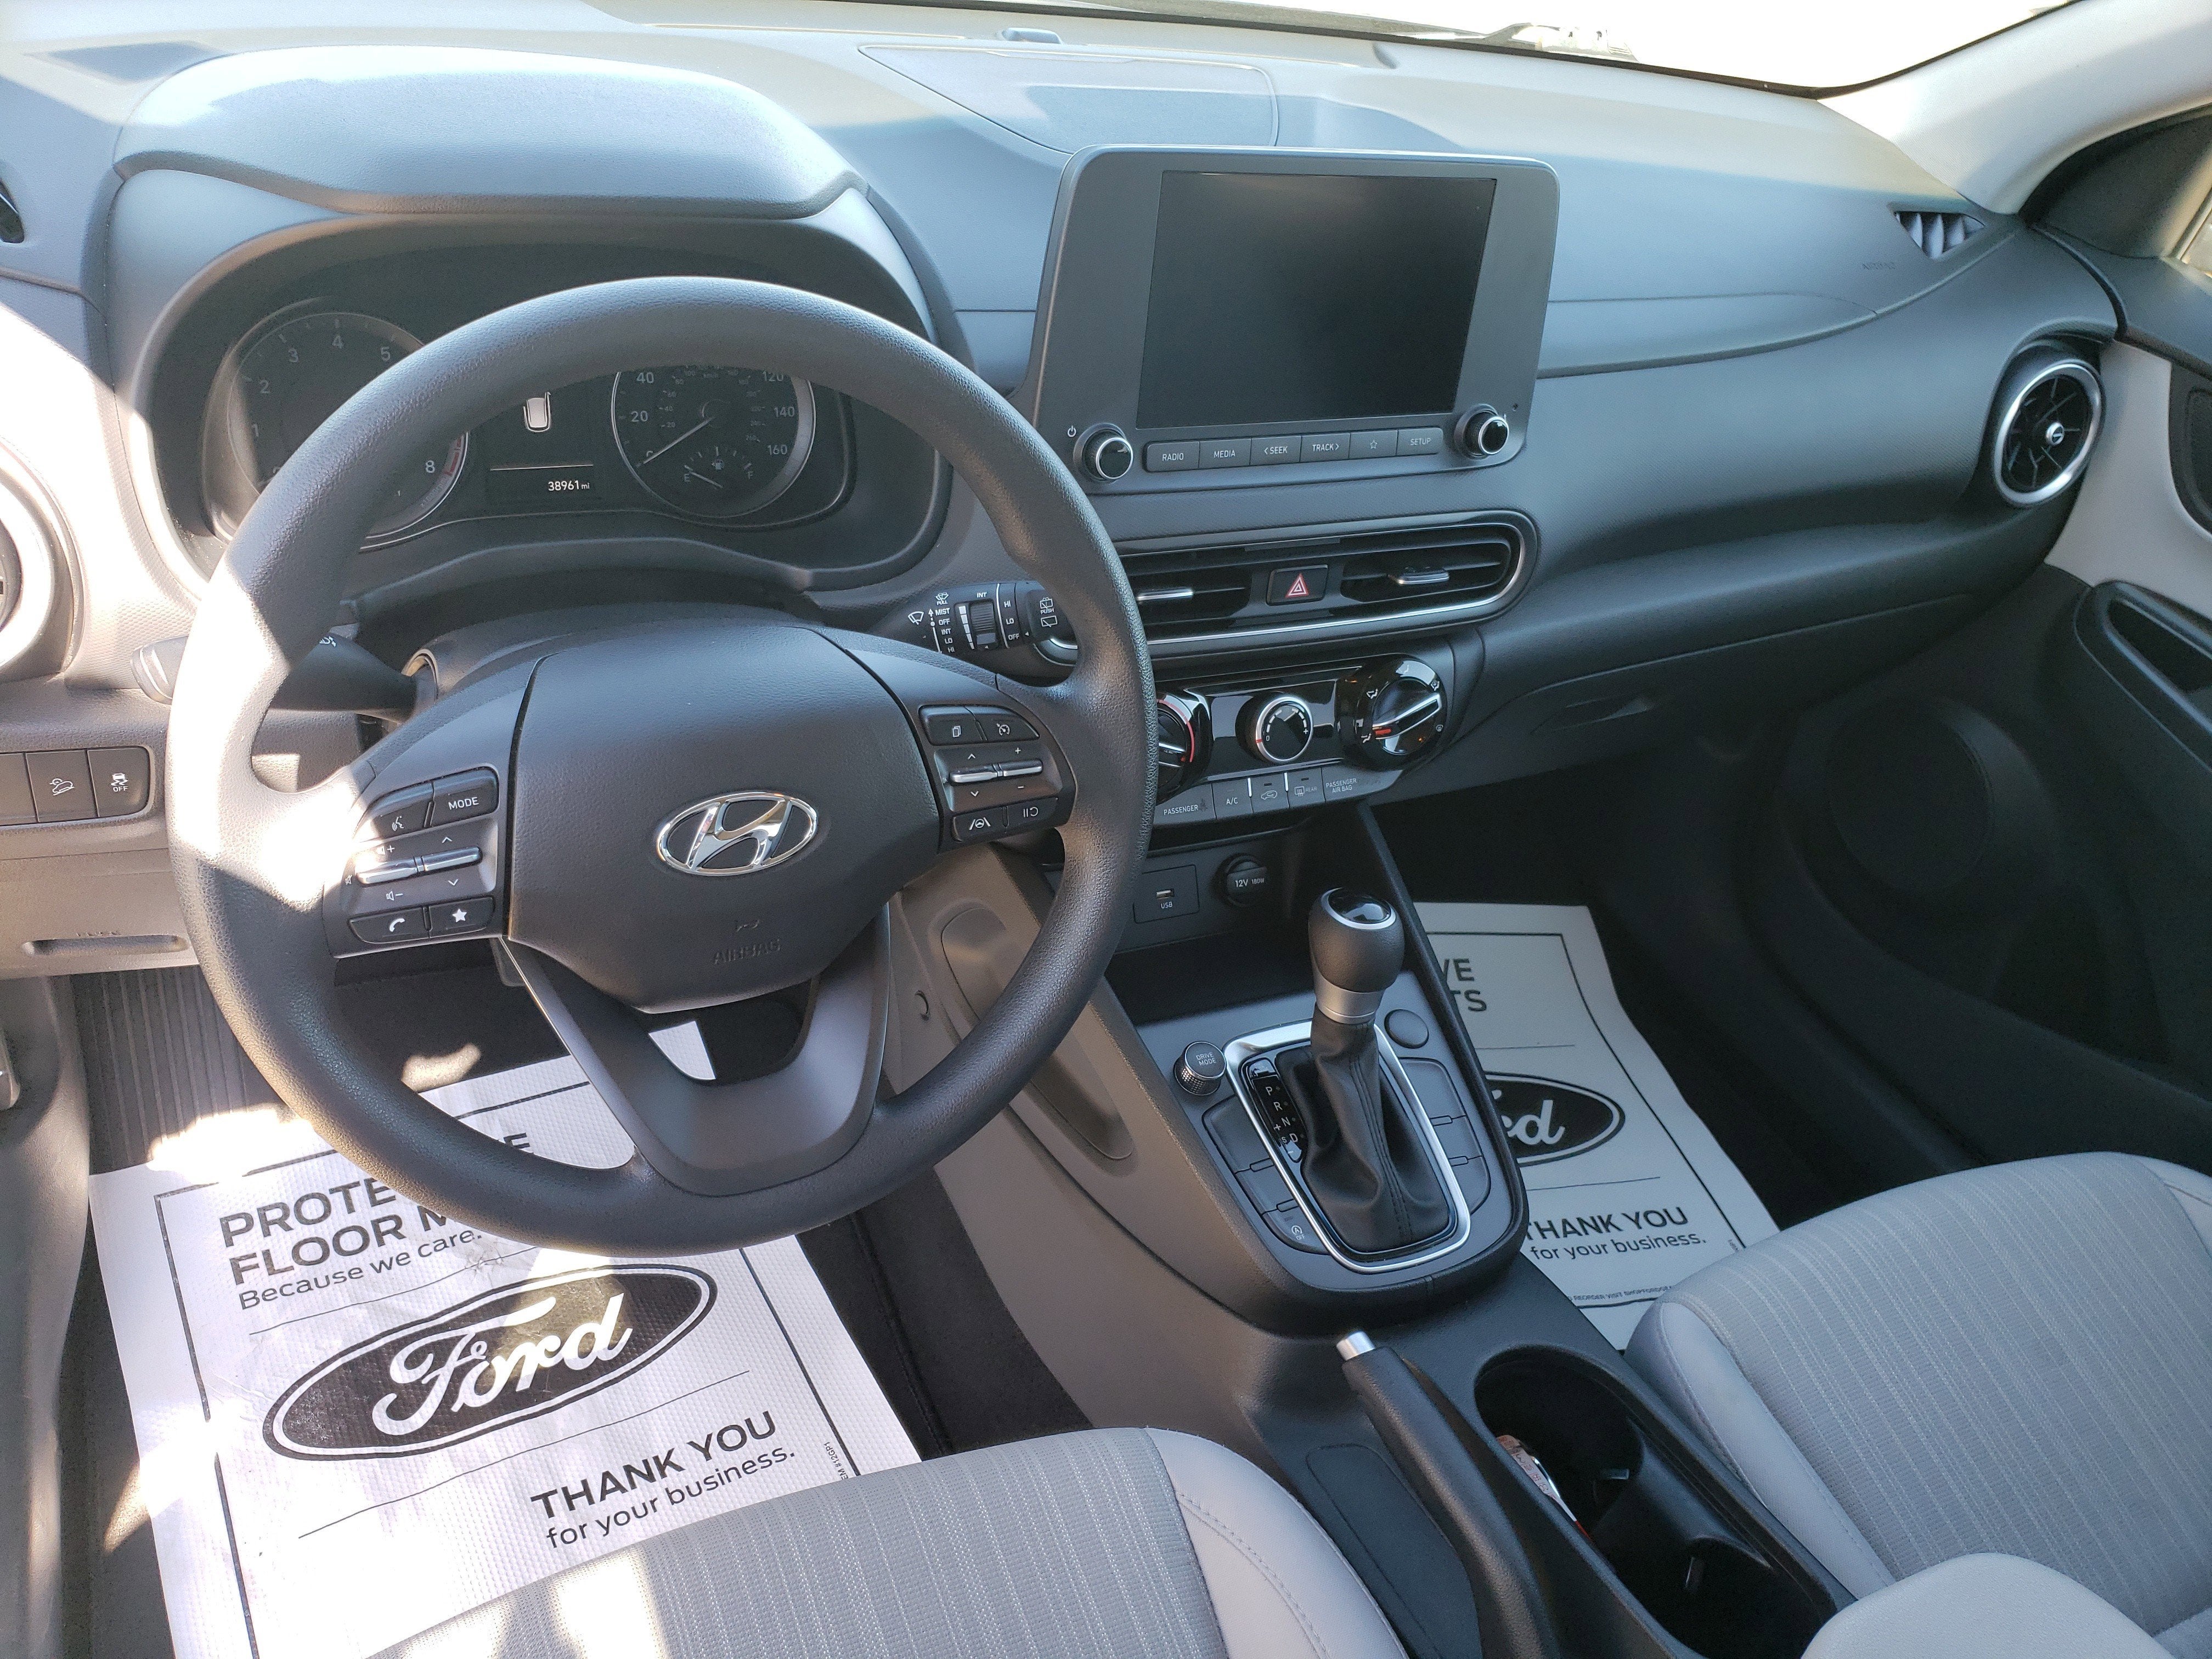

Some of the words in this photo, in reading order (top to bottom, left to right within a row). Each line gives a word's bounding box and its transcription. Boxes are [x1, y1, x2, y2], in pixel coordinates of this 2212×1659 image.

[331, 334, 345, 349] 4
[287, 347, 299, 363] 3
[380, 346, 391, 362] 5
[636, 372, 654, 383] 40
[258, 379, 271, 394] 2
[631, 410, 648, 422] 20
[774, 407, 795, 417] 140
[252, 424, 259, 437] 1
[768, 444, 788, 455] 160
[1269, 445, 1288, 454] SEEK
[1312, 443, 1334, 452] TRACK
[1162, 453, 1184, 461] RADIO
[1214, 450, 1236, 458] MEDIA
[425, 460, 436, 473] 8
[548, 480, 579, 491] 38961
[1004, 600, 1011, 608] HI
[935, 607, 950, 616] MIST
[1325, 778, 1357, 788] PASSENGER
[448, 796, 479, 810] MODE
[1226, 797, 1238, 805] A/C
[1164, 804, 1198, 816] PASSENGER
[1235, 879, 1248, 888] 12V
[1195, 1052, 1214, 1060] DRIVE
[1198, 1057, 1217, 1066] MODE
[1265, 1086, 1273, 1096] P
[1273, 1101, 1283, 1111] R
[1281, 1116, 1291, 1127] N
[1289, 1133, 1299, 1143] D
[1621, 1206, 1689, 1230] YOU
[229, 1214, 407, 1285] FLOOR
[1530, 1246, 1560, 1260] for
[1562, 1243, 1609, 1260] your
[1610, 1233, 1707, 1253] business.
[239, 1266, 365, 1310] Because
[369, 1251, 411, 1274] we
[417, 1229, 482, 1258] care.
[372, 1292, 634, 1436] Ford
[823, 1441, 842, 1468] #12GP1
[530, 1447, 686, 1519] THANK
[686, 1410, 776, 1462] YOU
[837, 1468, 849, 1480] EM
[546, 1522, 588, 1549] for
[595, 1497, 658, 1537] your
[665, 1446, 795, 1506] business.
